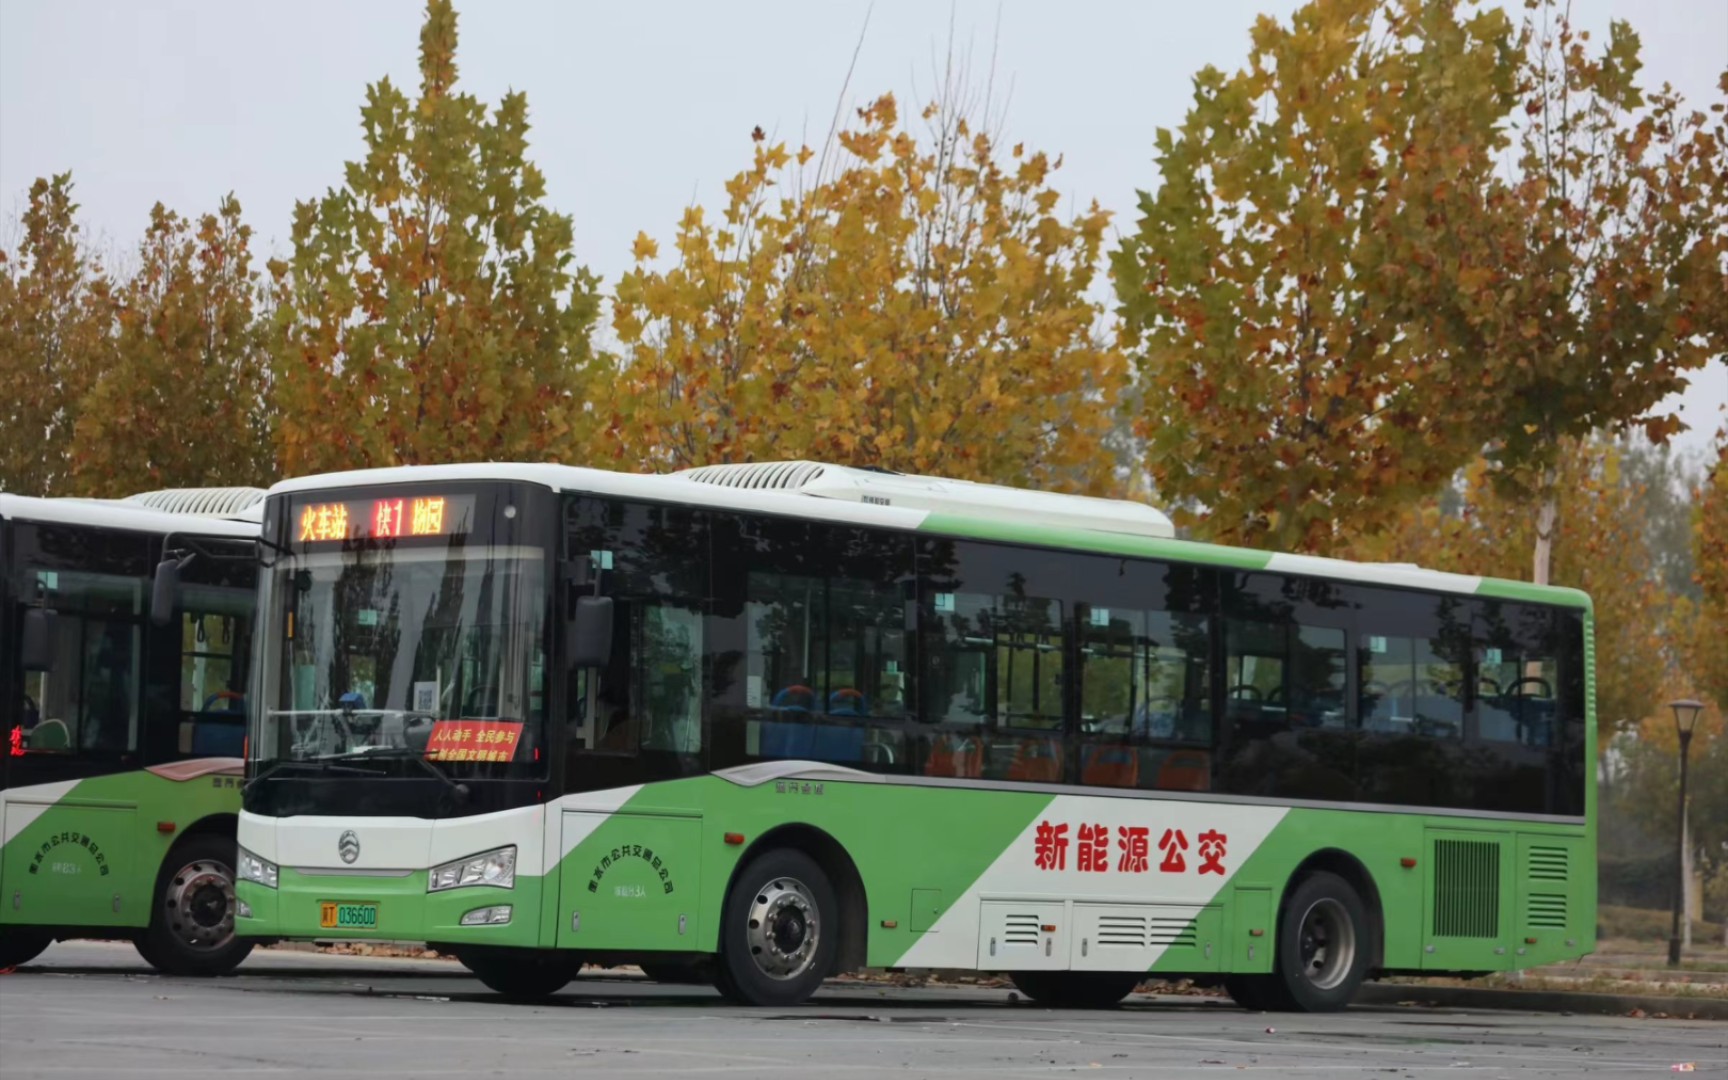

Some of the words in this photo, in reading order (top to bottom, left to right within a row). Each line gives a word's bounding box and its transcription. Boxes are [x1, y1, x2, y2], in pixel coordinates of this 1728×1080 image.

[300, 503, 348, 541] 火车站
[375, 499, 403, 538] 快1
[1034, 820, 1227, 876] 新能源公交
